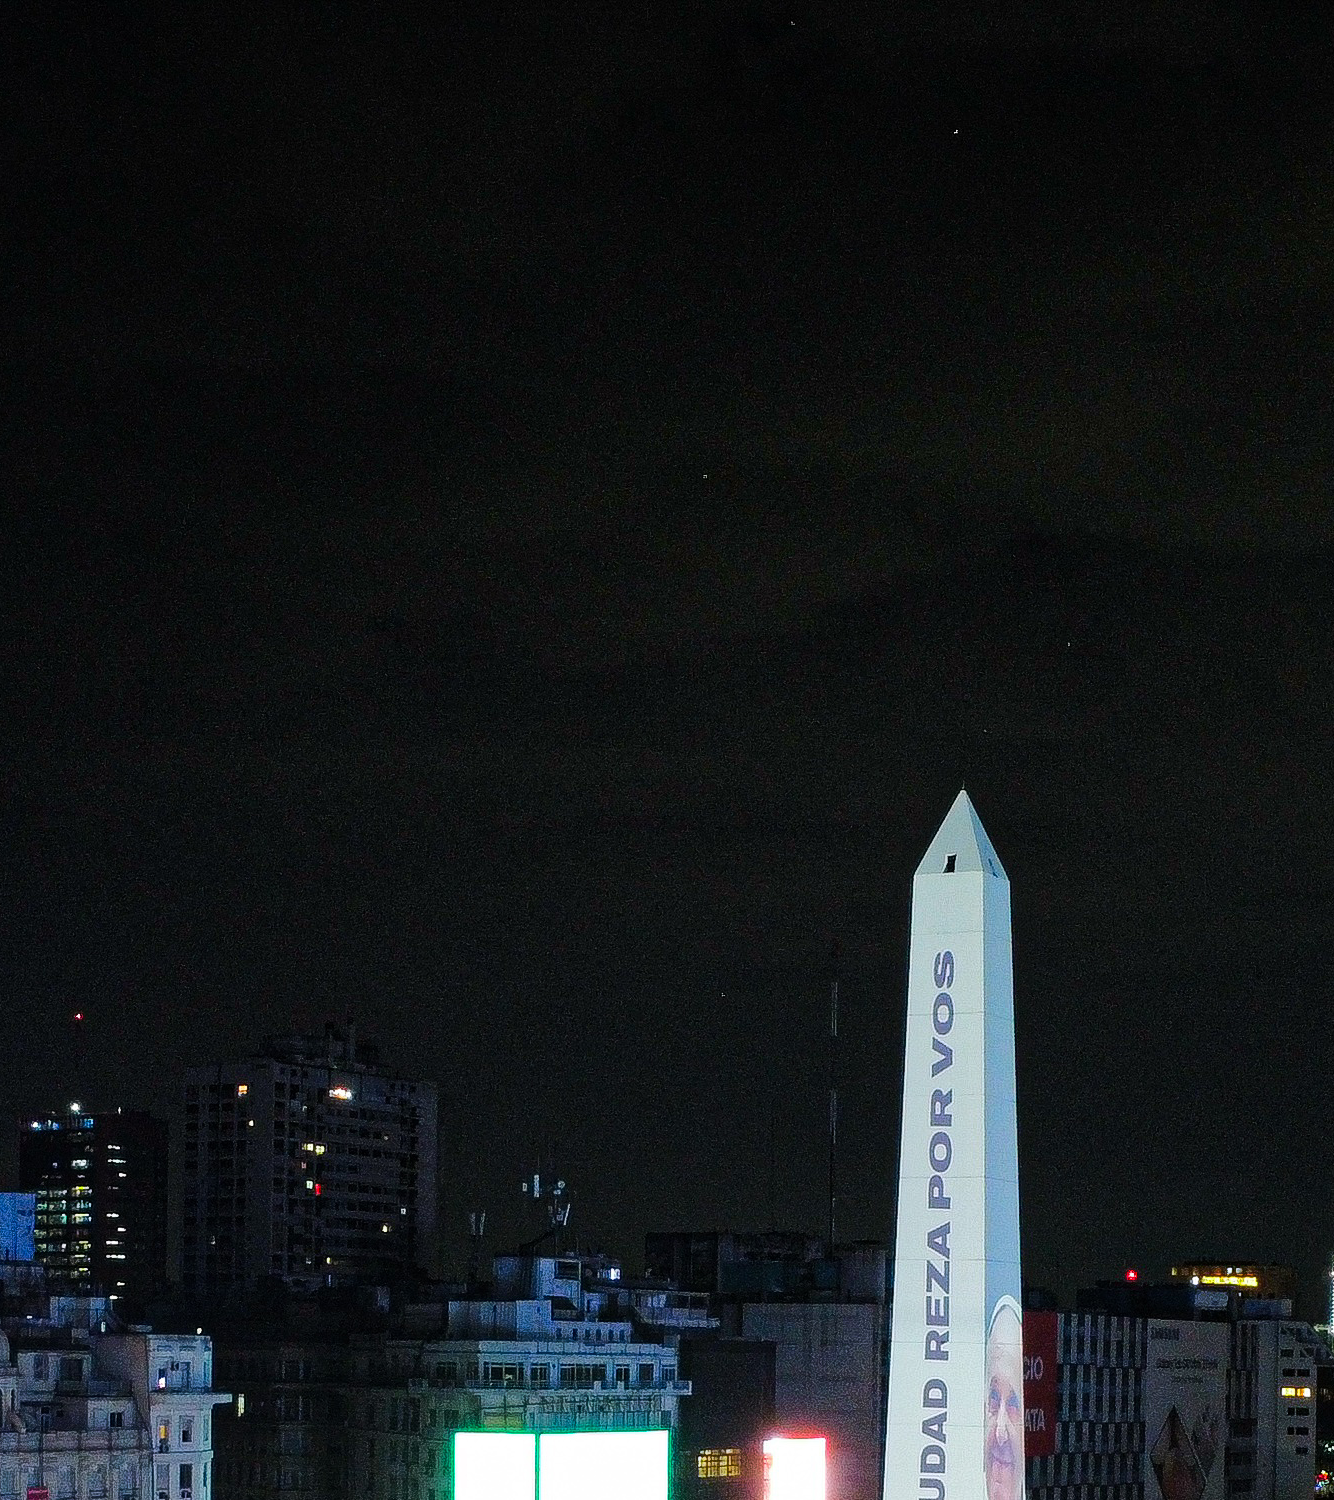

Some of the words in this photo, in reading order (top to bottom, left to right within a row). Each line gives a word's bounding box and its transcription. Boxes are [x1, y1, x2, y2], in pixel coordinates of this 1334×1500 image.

[932, 951, 954, 1078] VOS
[928, 1089, 953, 1209] POR
[925, 1222, 950, 1361] REZA
